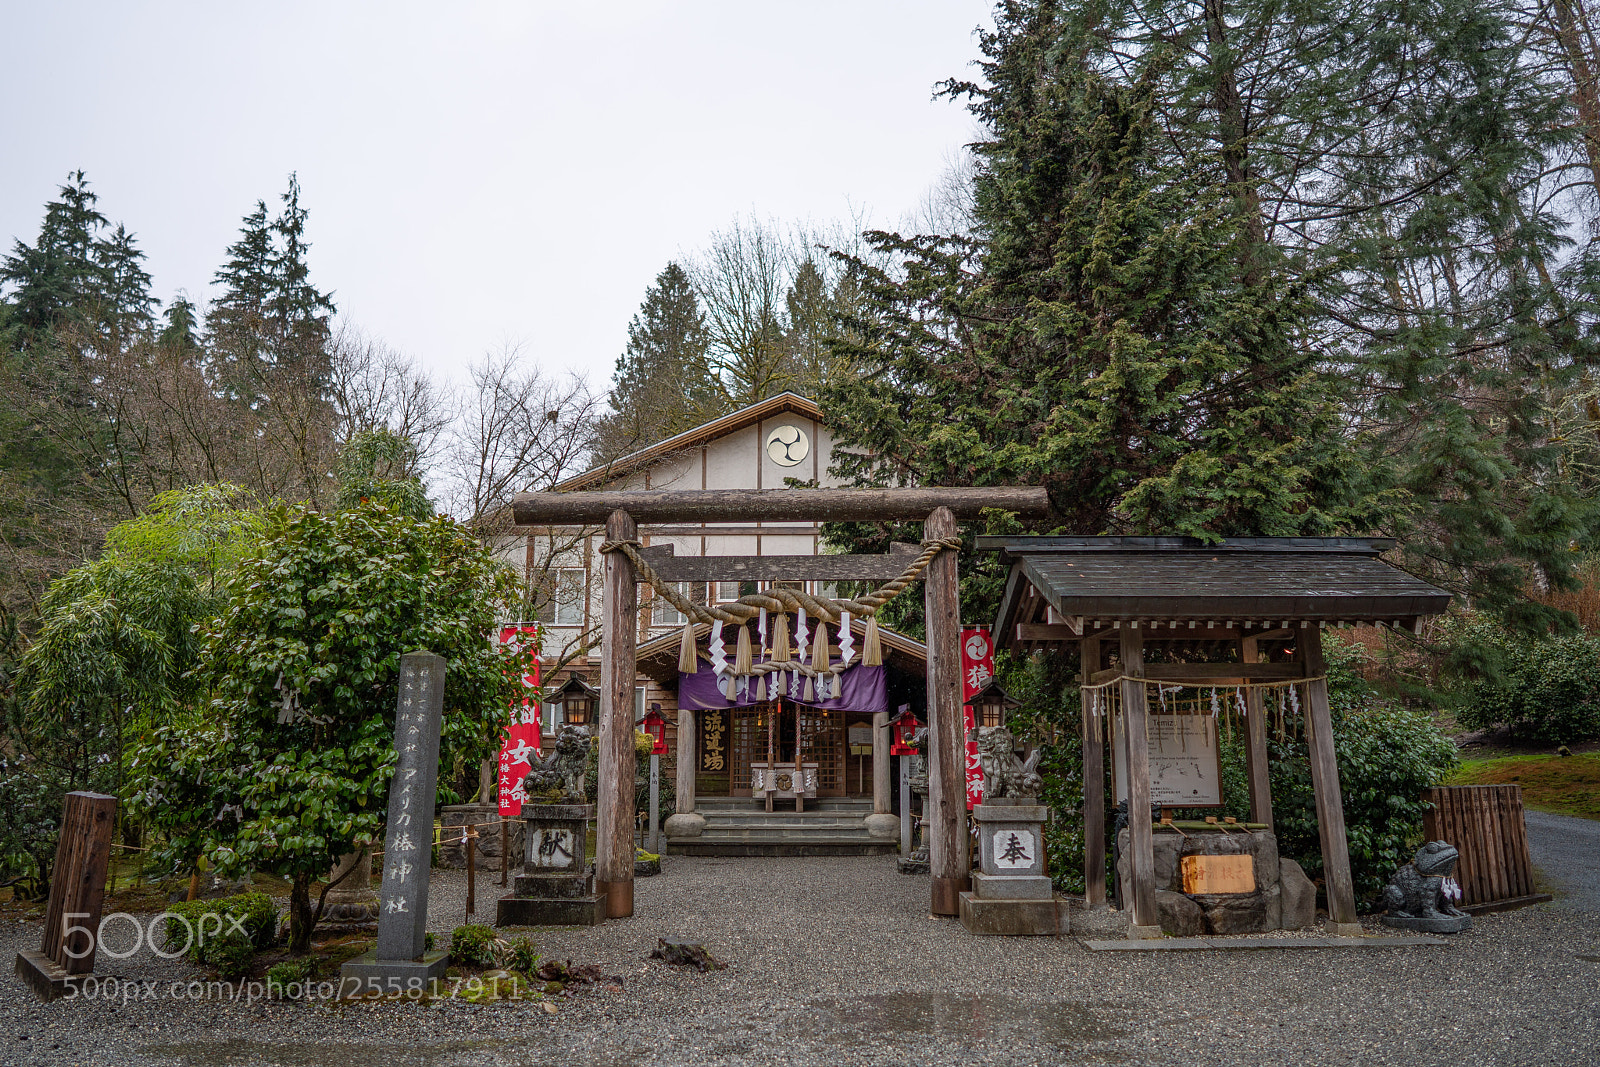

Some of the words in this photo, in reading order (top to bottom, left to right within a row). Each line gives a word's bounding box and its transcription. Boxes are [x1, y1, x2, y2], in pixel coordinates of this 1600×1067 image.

[499, 729, 511, 809] リカ椿大神社
[704, 709, 726, 771] 流道場
[998, 832, 1031, 864] 奉
